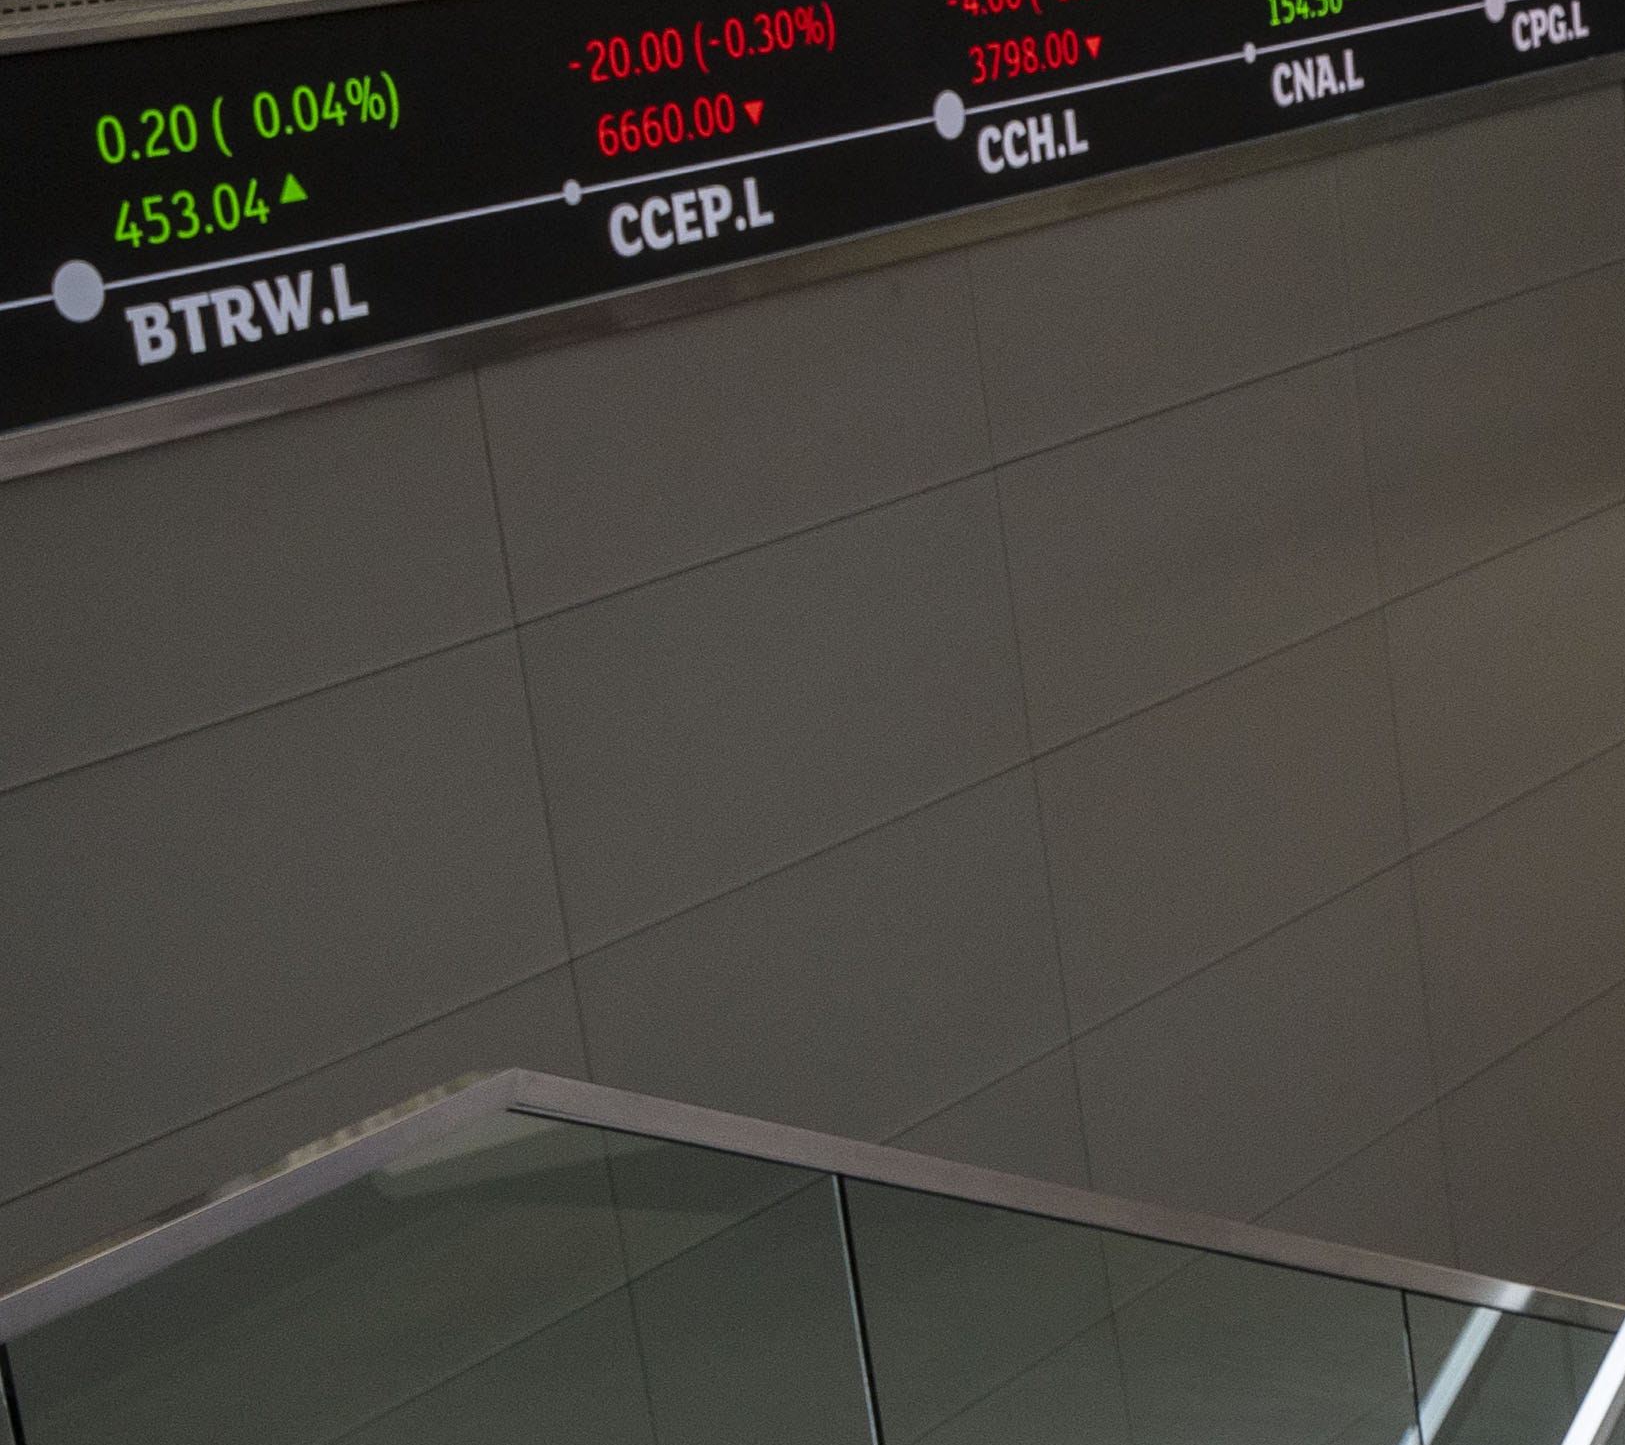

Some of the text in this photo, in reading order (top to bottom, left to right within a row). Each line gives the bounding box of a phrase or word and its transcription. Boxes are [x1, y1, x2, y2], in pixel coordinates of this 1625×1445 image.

[568, 1, 836, 83] -20.00 (-0.30%)
[968, 28, 1080, 85] 3798.00
[1511, 0, 1590, 52] CPG.L
[1271, 48, 1365, 107] CNA.L
[96, 104, 198, 164] 0.20
[597, 92, 736, 157] 6660.00
[977, 109, 1089, 174] CCH.L
[114, 178, 270, 248] 453.04
[609, 177, 775, 257] CCEP.L
[124, 262, 370, 366] BTRW.L
